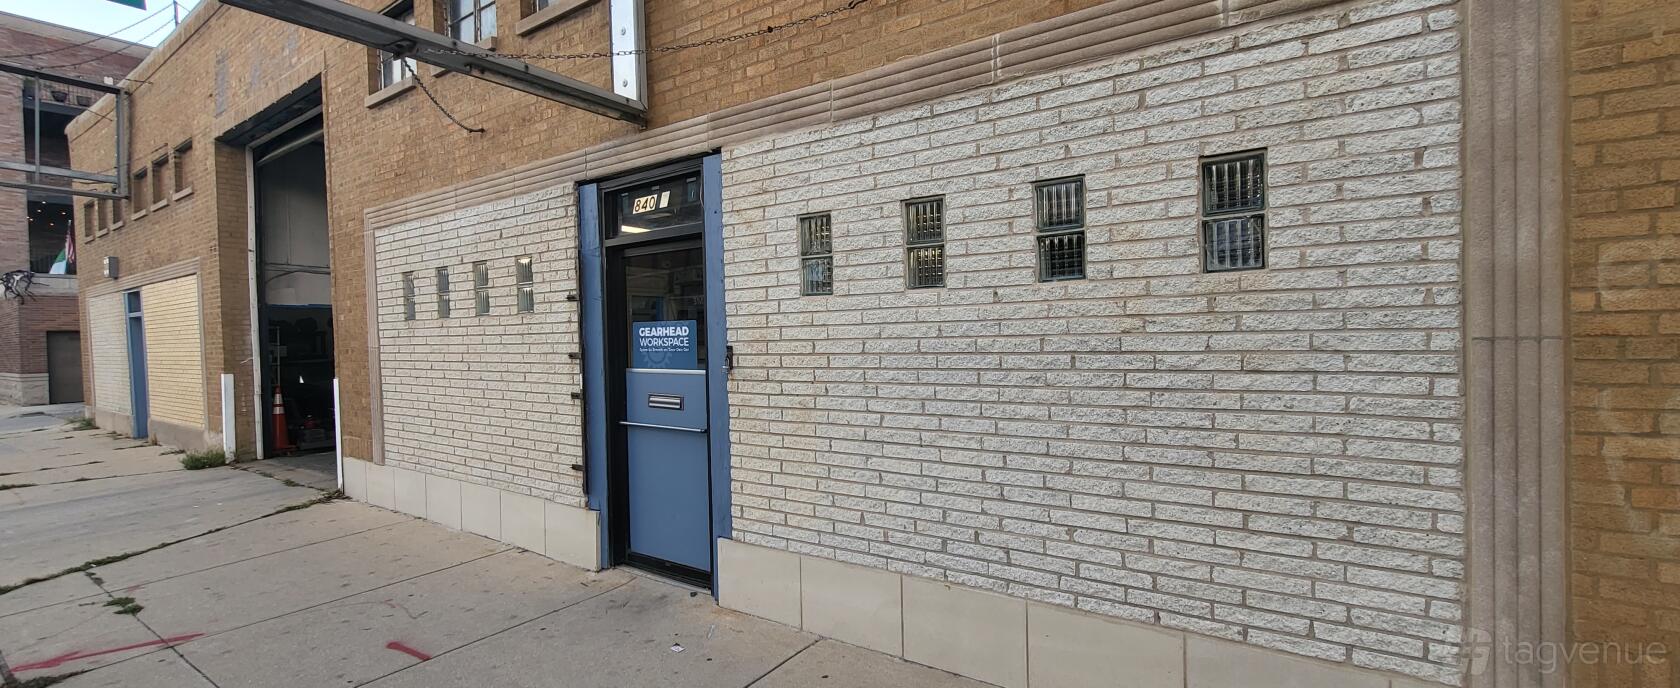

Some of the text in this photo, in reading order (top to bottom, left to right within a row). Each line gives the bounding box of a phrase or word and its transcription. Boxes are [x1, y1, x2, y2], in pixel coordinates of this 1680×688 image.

[634, 196, 656, 212] 840
[639, 326, 689, 337] GEARHEAD
[639, 337, 689, 347] WORKSPACE
